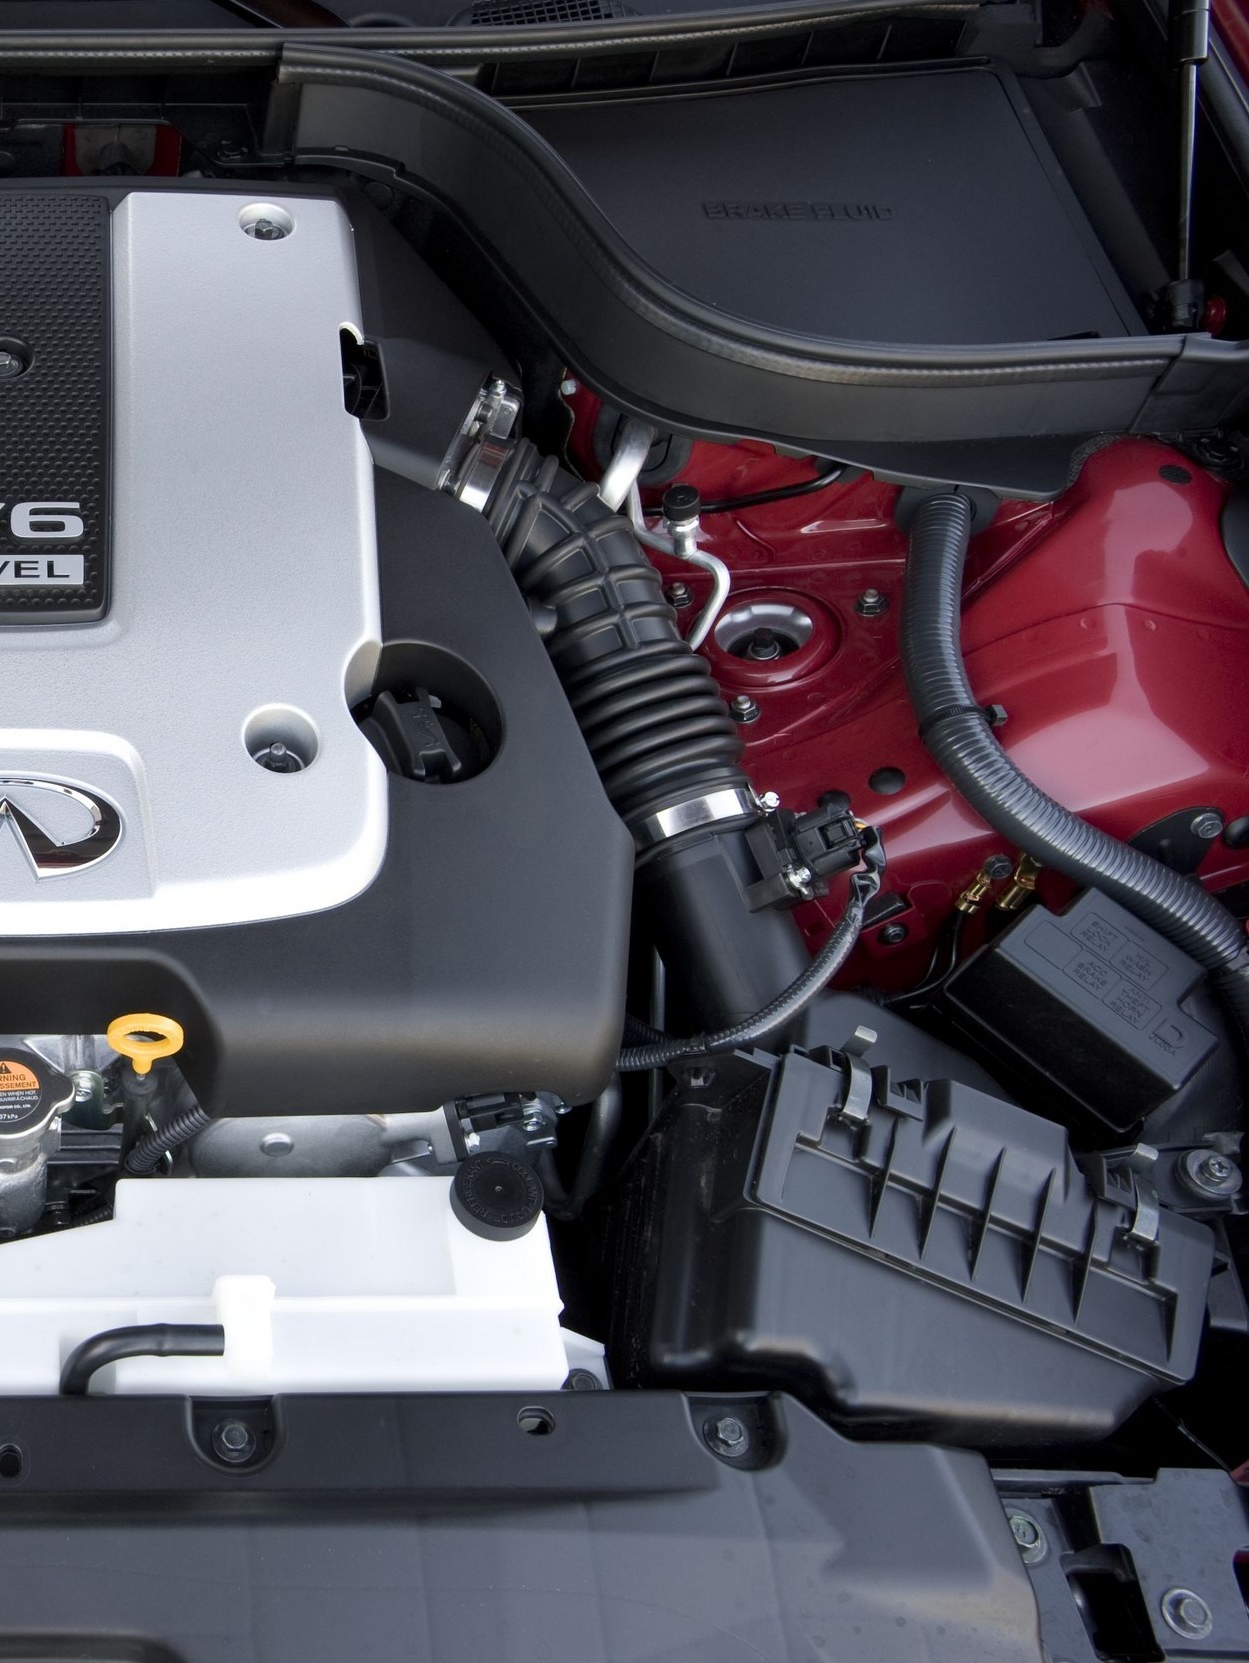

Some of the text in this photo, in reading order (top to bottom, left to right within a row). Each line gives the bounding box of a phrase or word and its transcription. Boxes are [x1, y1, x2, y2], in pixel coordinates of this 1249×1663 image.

[703, 203, 896, 220] BRAKE FLUID
[1086, 929, 1110, 946] LOCK
[1091, 921, 1118, 939] SHIFT
[1081, 931, 1107, 952] RELAY
[1072, 968, 1101, 990] RELAY
[1077, 962, 1108, 986] BRAKE
[1120, 959, 1146, 981] RELAY
[1122, 989, 1150, 1011] THEFT
[1110, 1001, 1138, 1024] RELAY
